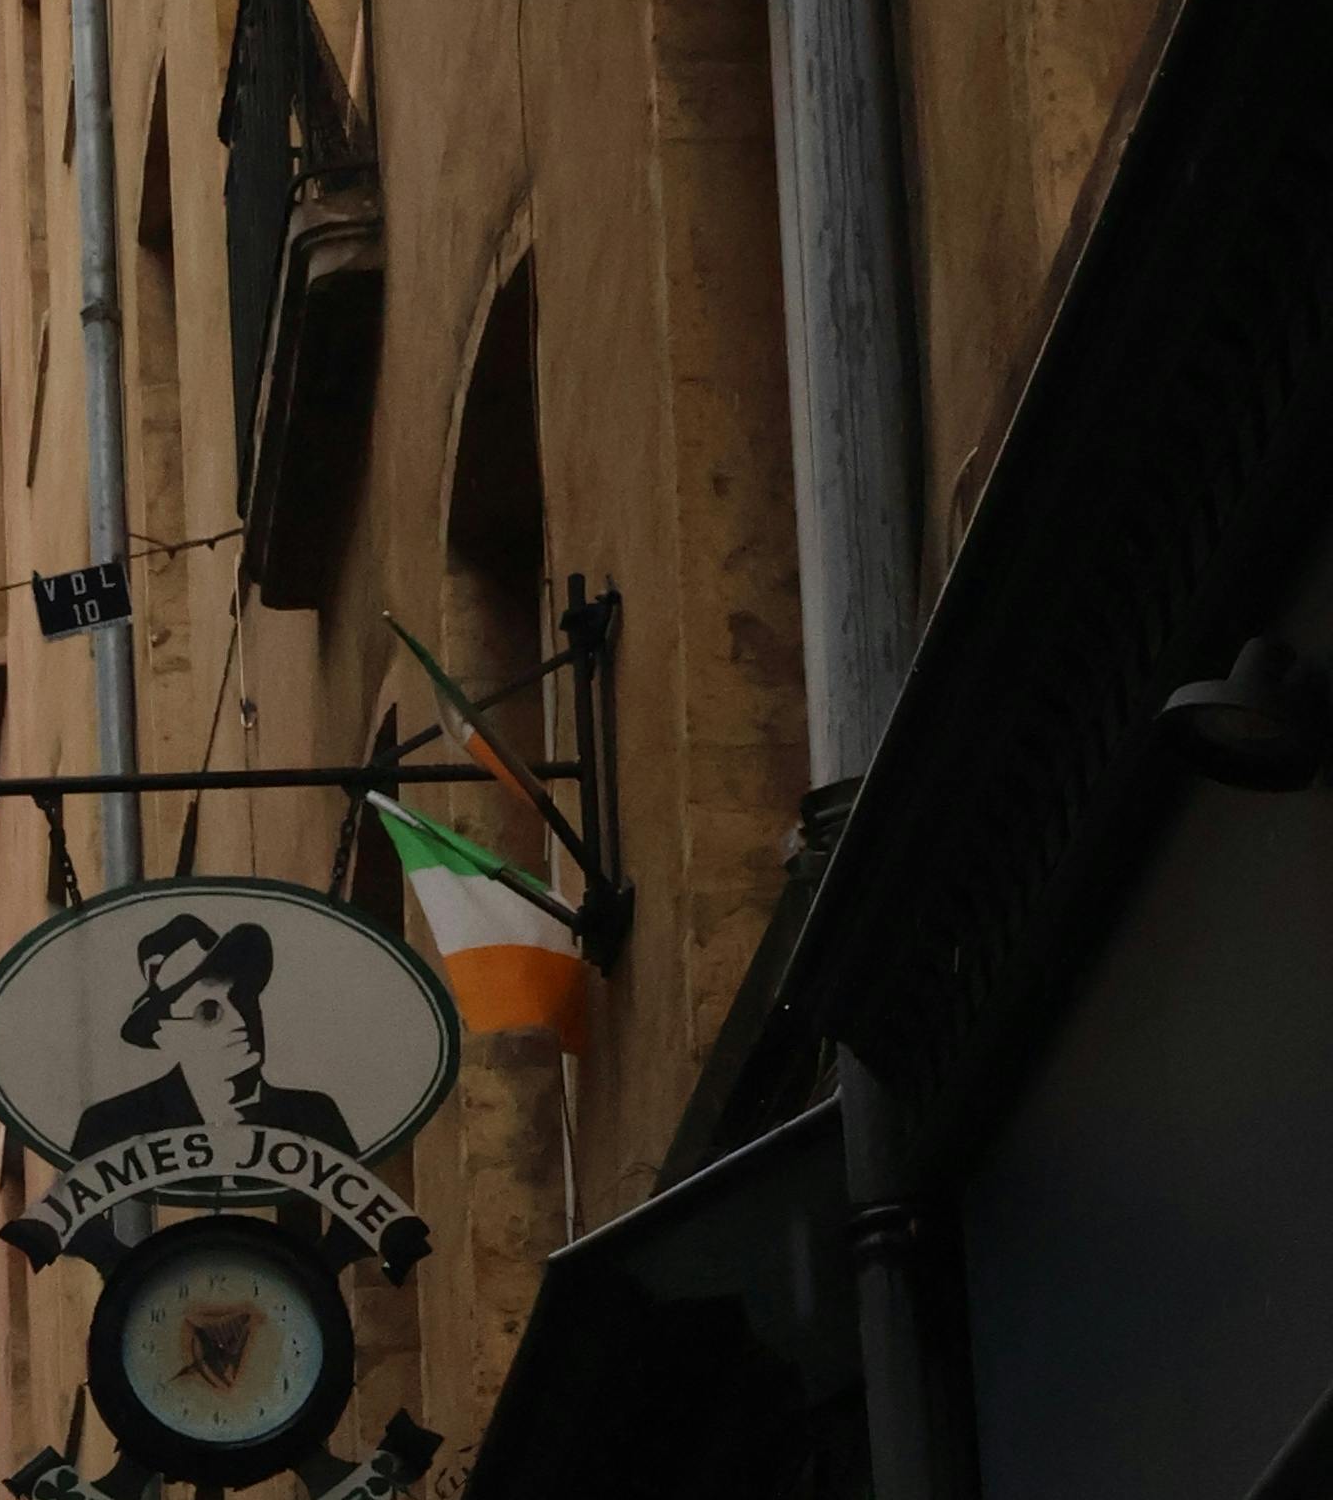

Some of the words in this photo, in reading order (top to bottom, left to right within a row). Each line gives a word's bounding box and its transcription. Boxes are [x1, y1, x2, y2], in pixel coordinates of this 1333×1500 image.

[72, 598, 101, 626] 10
[43, 1134, 214, 1237] JAMES
[236, 1132, 396, 1234] JOYCE
